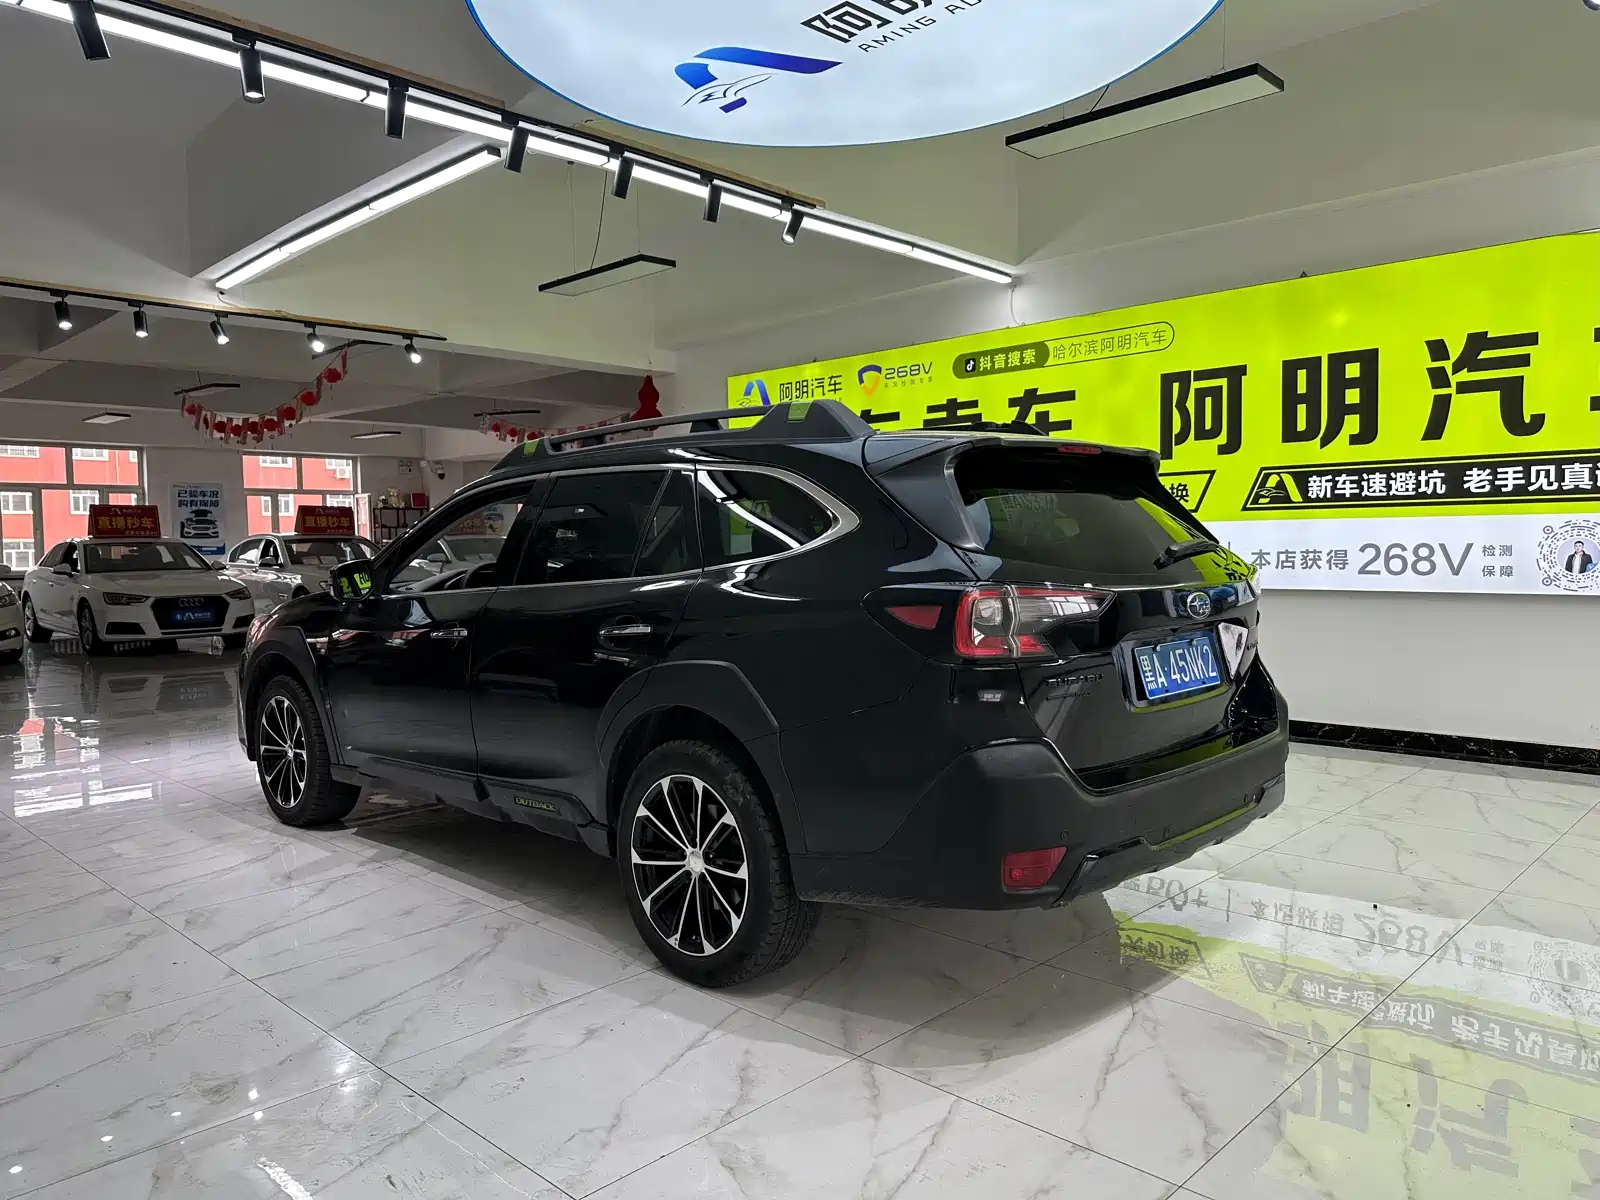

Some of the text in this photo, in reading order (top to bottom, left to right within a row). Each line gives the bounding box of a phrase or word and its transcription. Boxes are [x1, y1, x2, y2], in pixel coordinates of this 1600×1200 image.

[857, 15, 937, 53] AMING
[1052, 328, 1168, 360] 哈尔滨阿明汽车
[884, 361, 933, 380] 268V
[978, 348, 1037, 372] 抖音搜索
[779, 374, 844, 401] 阿明汽车
[1160, 327, 1600, 461] 阿明汽
[1307, 469, 1447, 500] 新车速避坑
[1250, 543, 1475, 576] 本店获得 268V
[1481, 544, 1513, 557] 检测
[1481, 565, 1514, 578] 保障
